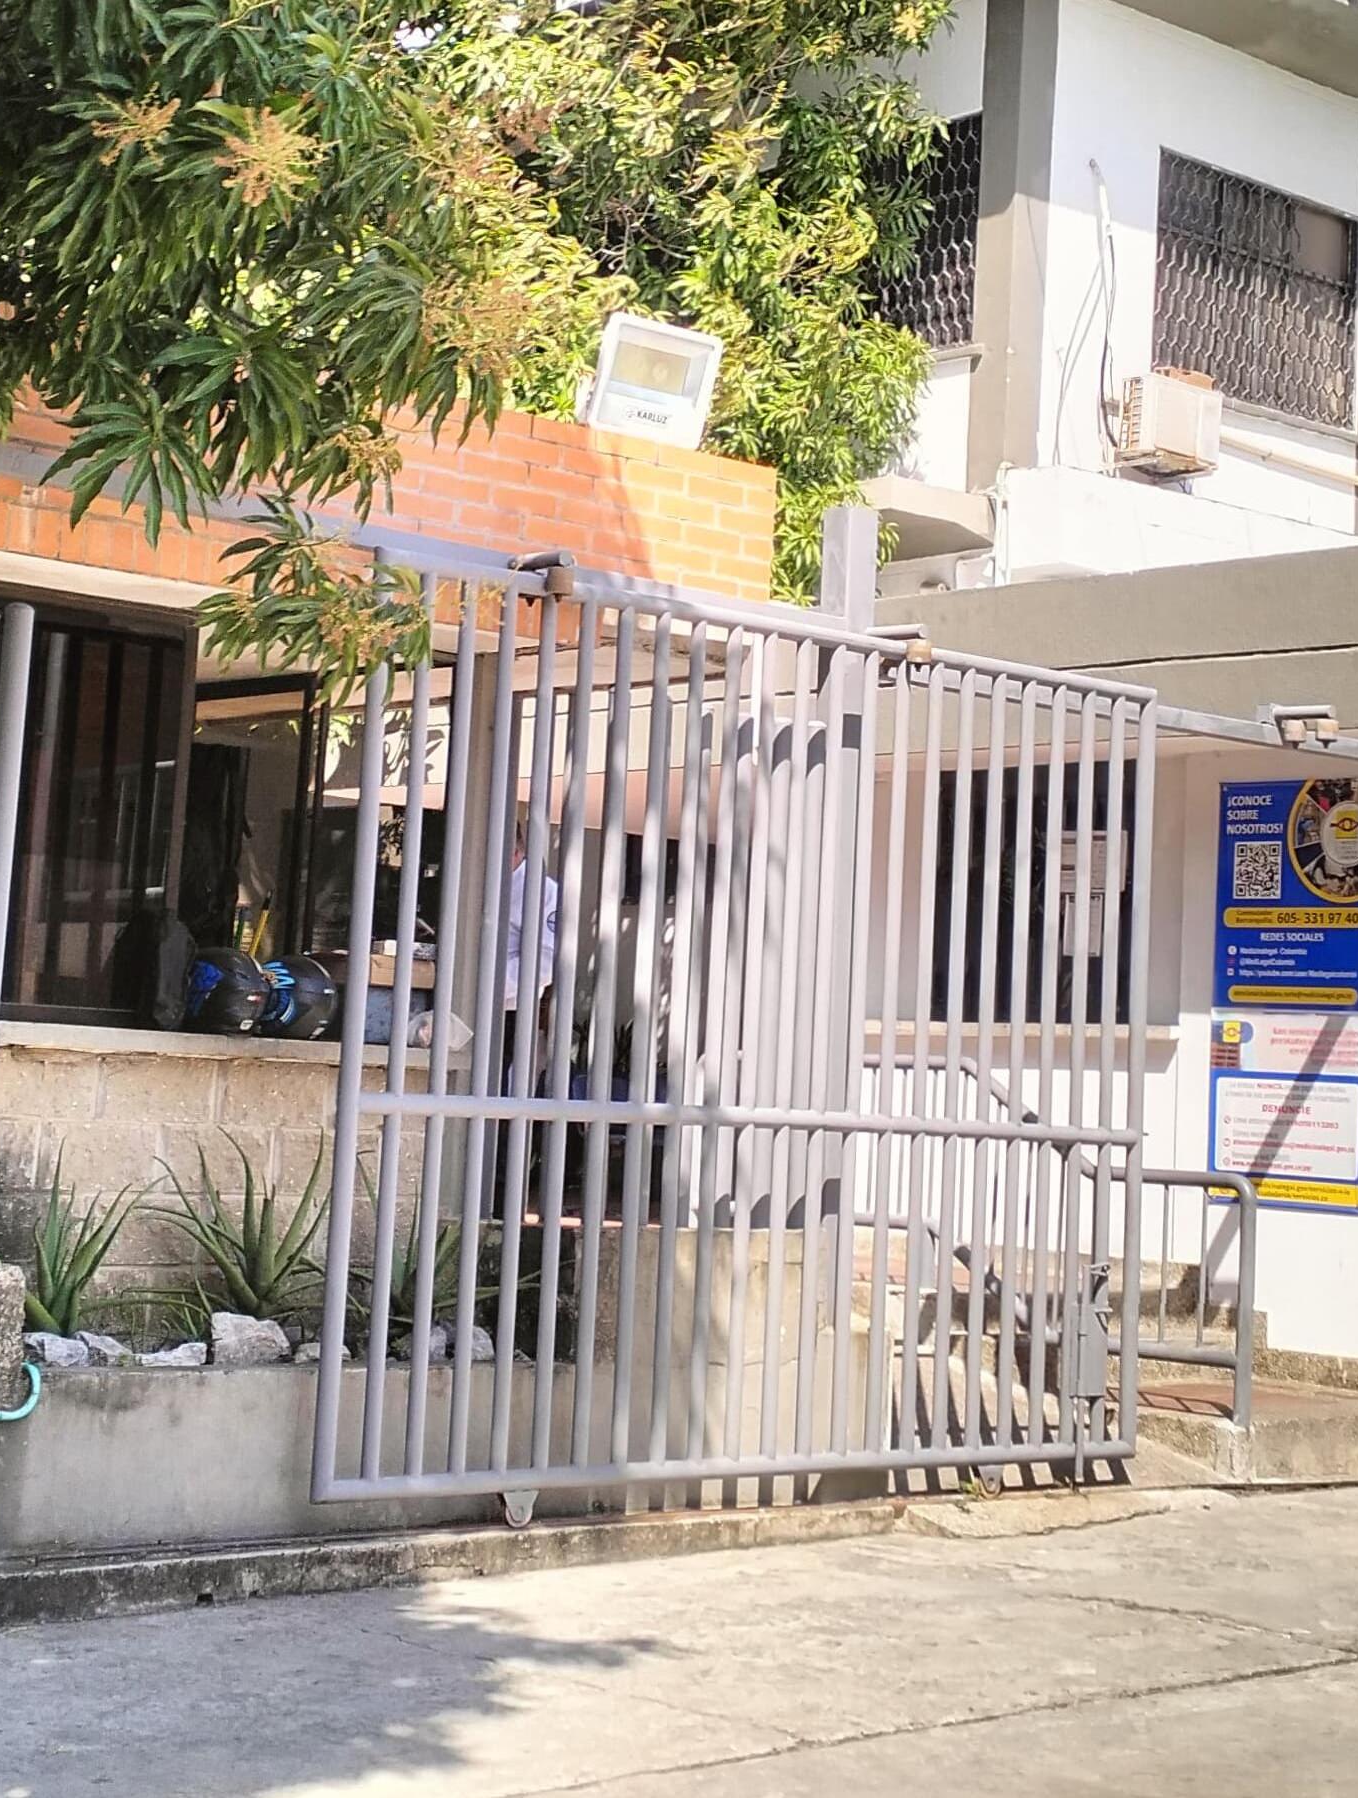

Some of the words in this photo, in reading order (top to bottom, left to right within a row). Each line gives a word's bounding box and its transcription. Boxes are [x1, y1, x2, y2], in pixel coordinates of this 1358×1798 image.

[1227, 795, 1273, 807] ¡CONOCE
[1227, 810, 1259, 820] SOBRE
[1227, 823, 1283, 835] NOSOTROS!
[1277, 912, 1300, 924] 605-
[1304, 912, 1324, 924] 331
[1328, 912, 1342, 924] 97
[1260, 932, 1285, 942] REDES
[1287, 932, 1324, 942] SOCIALES
[1262, 1104, 1311, 1115] DENUNCIE
